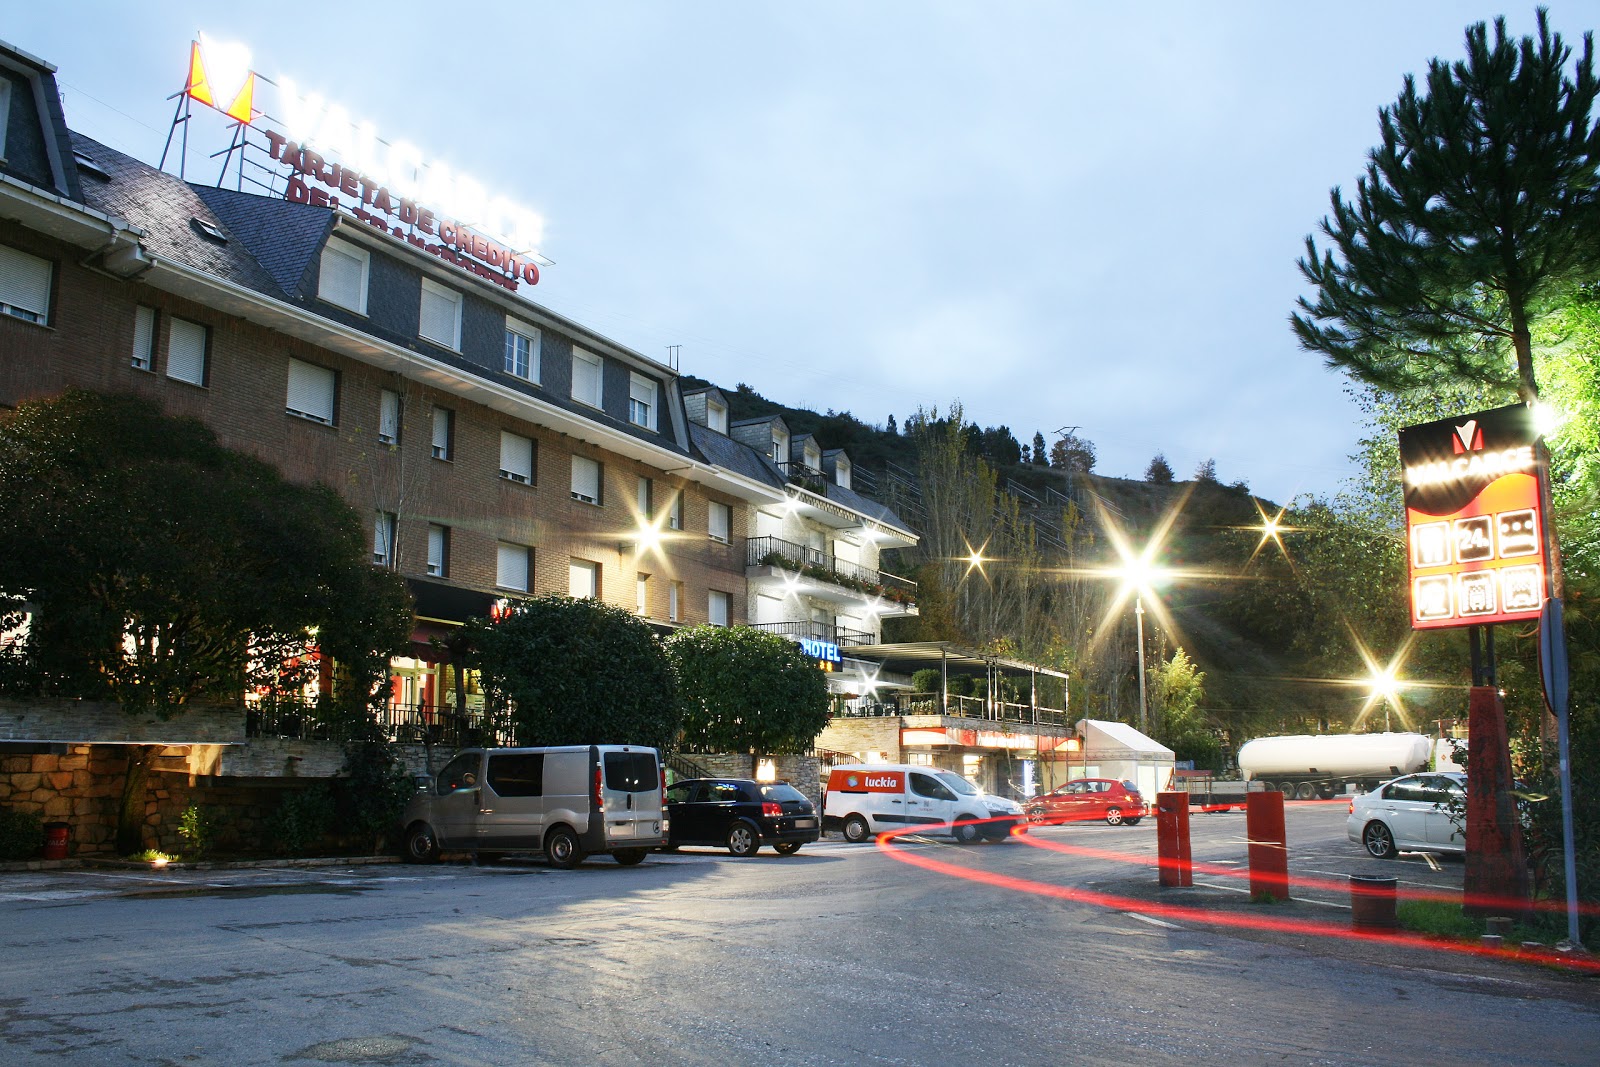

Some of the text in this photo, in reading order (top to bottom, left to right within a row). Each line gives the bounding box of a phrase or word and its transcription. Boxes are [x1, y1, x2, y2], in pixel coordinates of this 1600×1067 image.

[265, 129, 541, 286] TARJETA DE CREDITO
[803, 638, 841, 662] HOTEL
[864, 776, 897, 788] luckia
